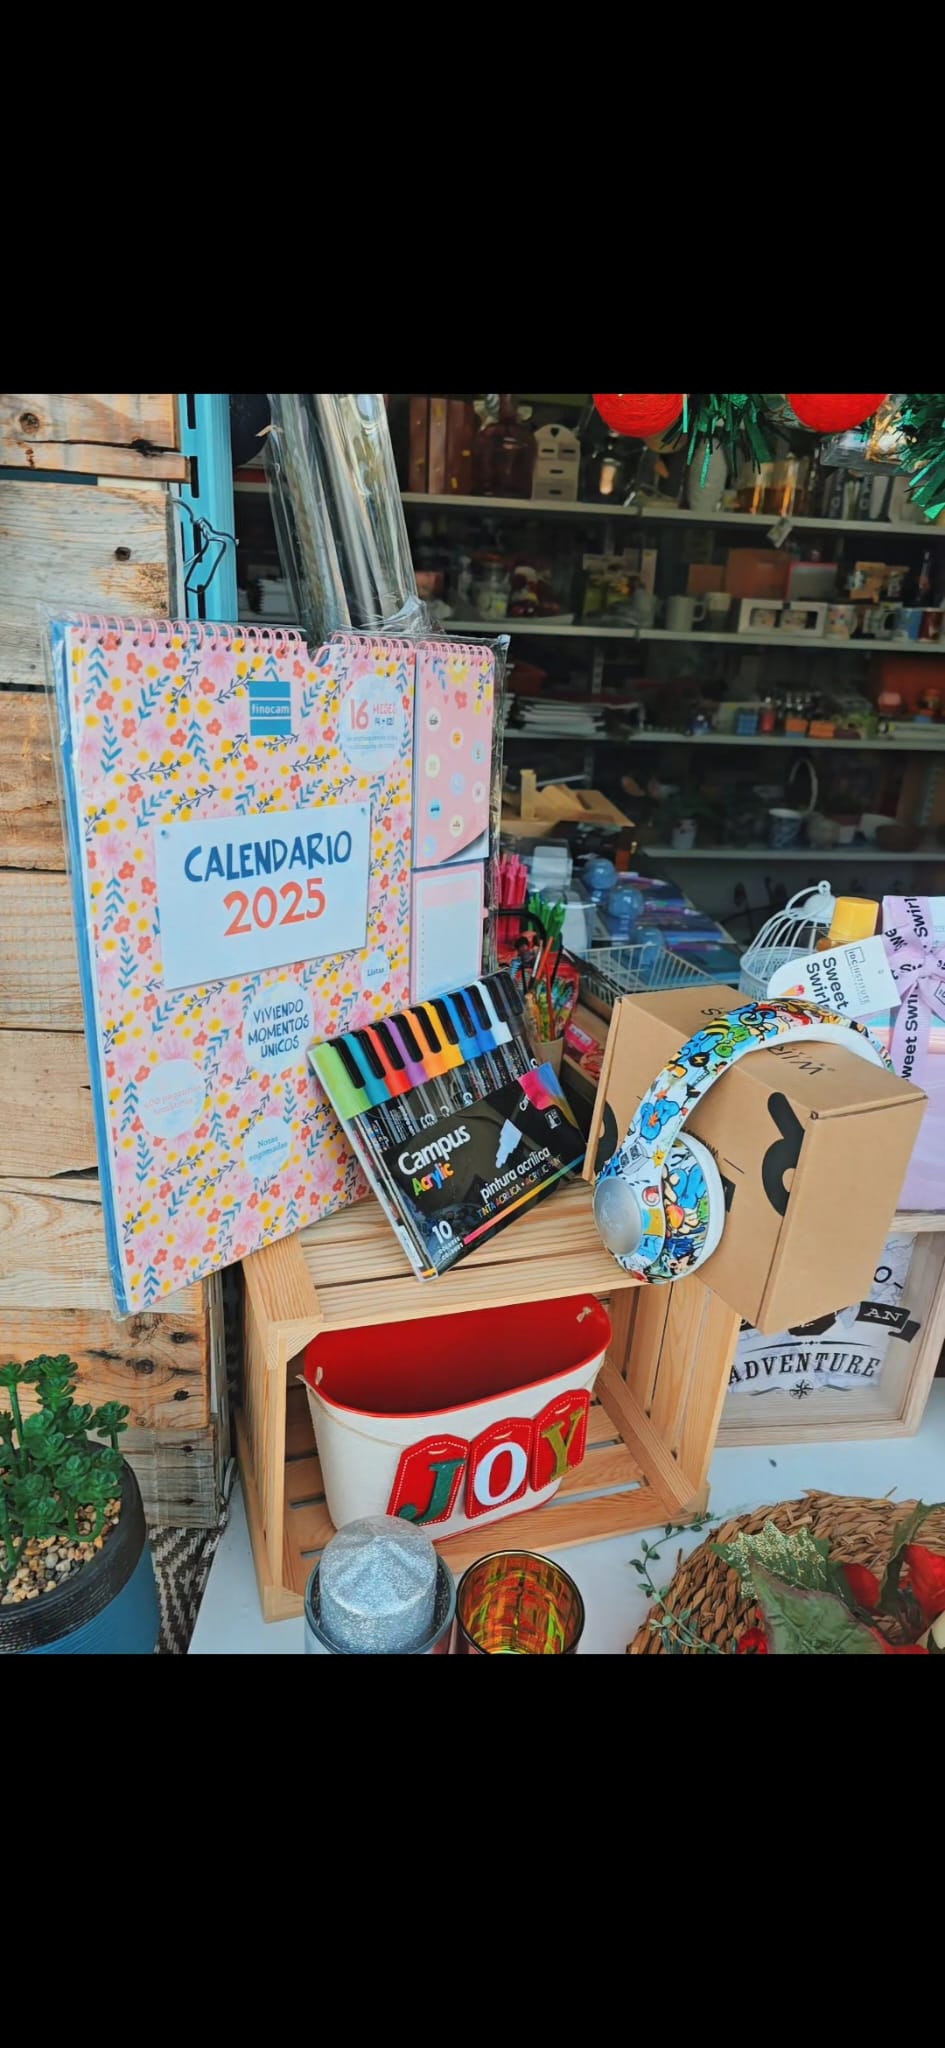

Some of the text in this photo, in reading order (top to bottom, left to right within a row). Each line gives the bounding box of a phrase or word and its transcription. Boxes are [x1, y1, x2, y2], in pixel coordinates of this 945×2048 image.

[251, 703, 290, 715] finocam
[350, 699, 369, 730] 16
[184, 830, 352, 882] CALENDARIO
[223, 877, 326, 936] 2025
[823, 957, 849, 1010] Sweet
[253, 999, 304, 1024] VIVIENDO
[248, 1013, 310, 1046] MOMENTOS
[901, 1036, 918, 1081] weet
[398, 1125, 471, 1175] Campus
[411, 1162, 454, 1196] Acrylic
[480, 1169, 518, 1204] pintura
[432, 1220, 453, 1244] 10
[864, 1308, 903, 1323] AN
[728, 1352, 882, 1386] ADVENTURE
[398, 1406, 586, 1525] JOY
